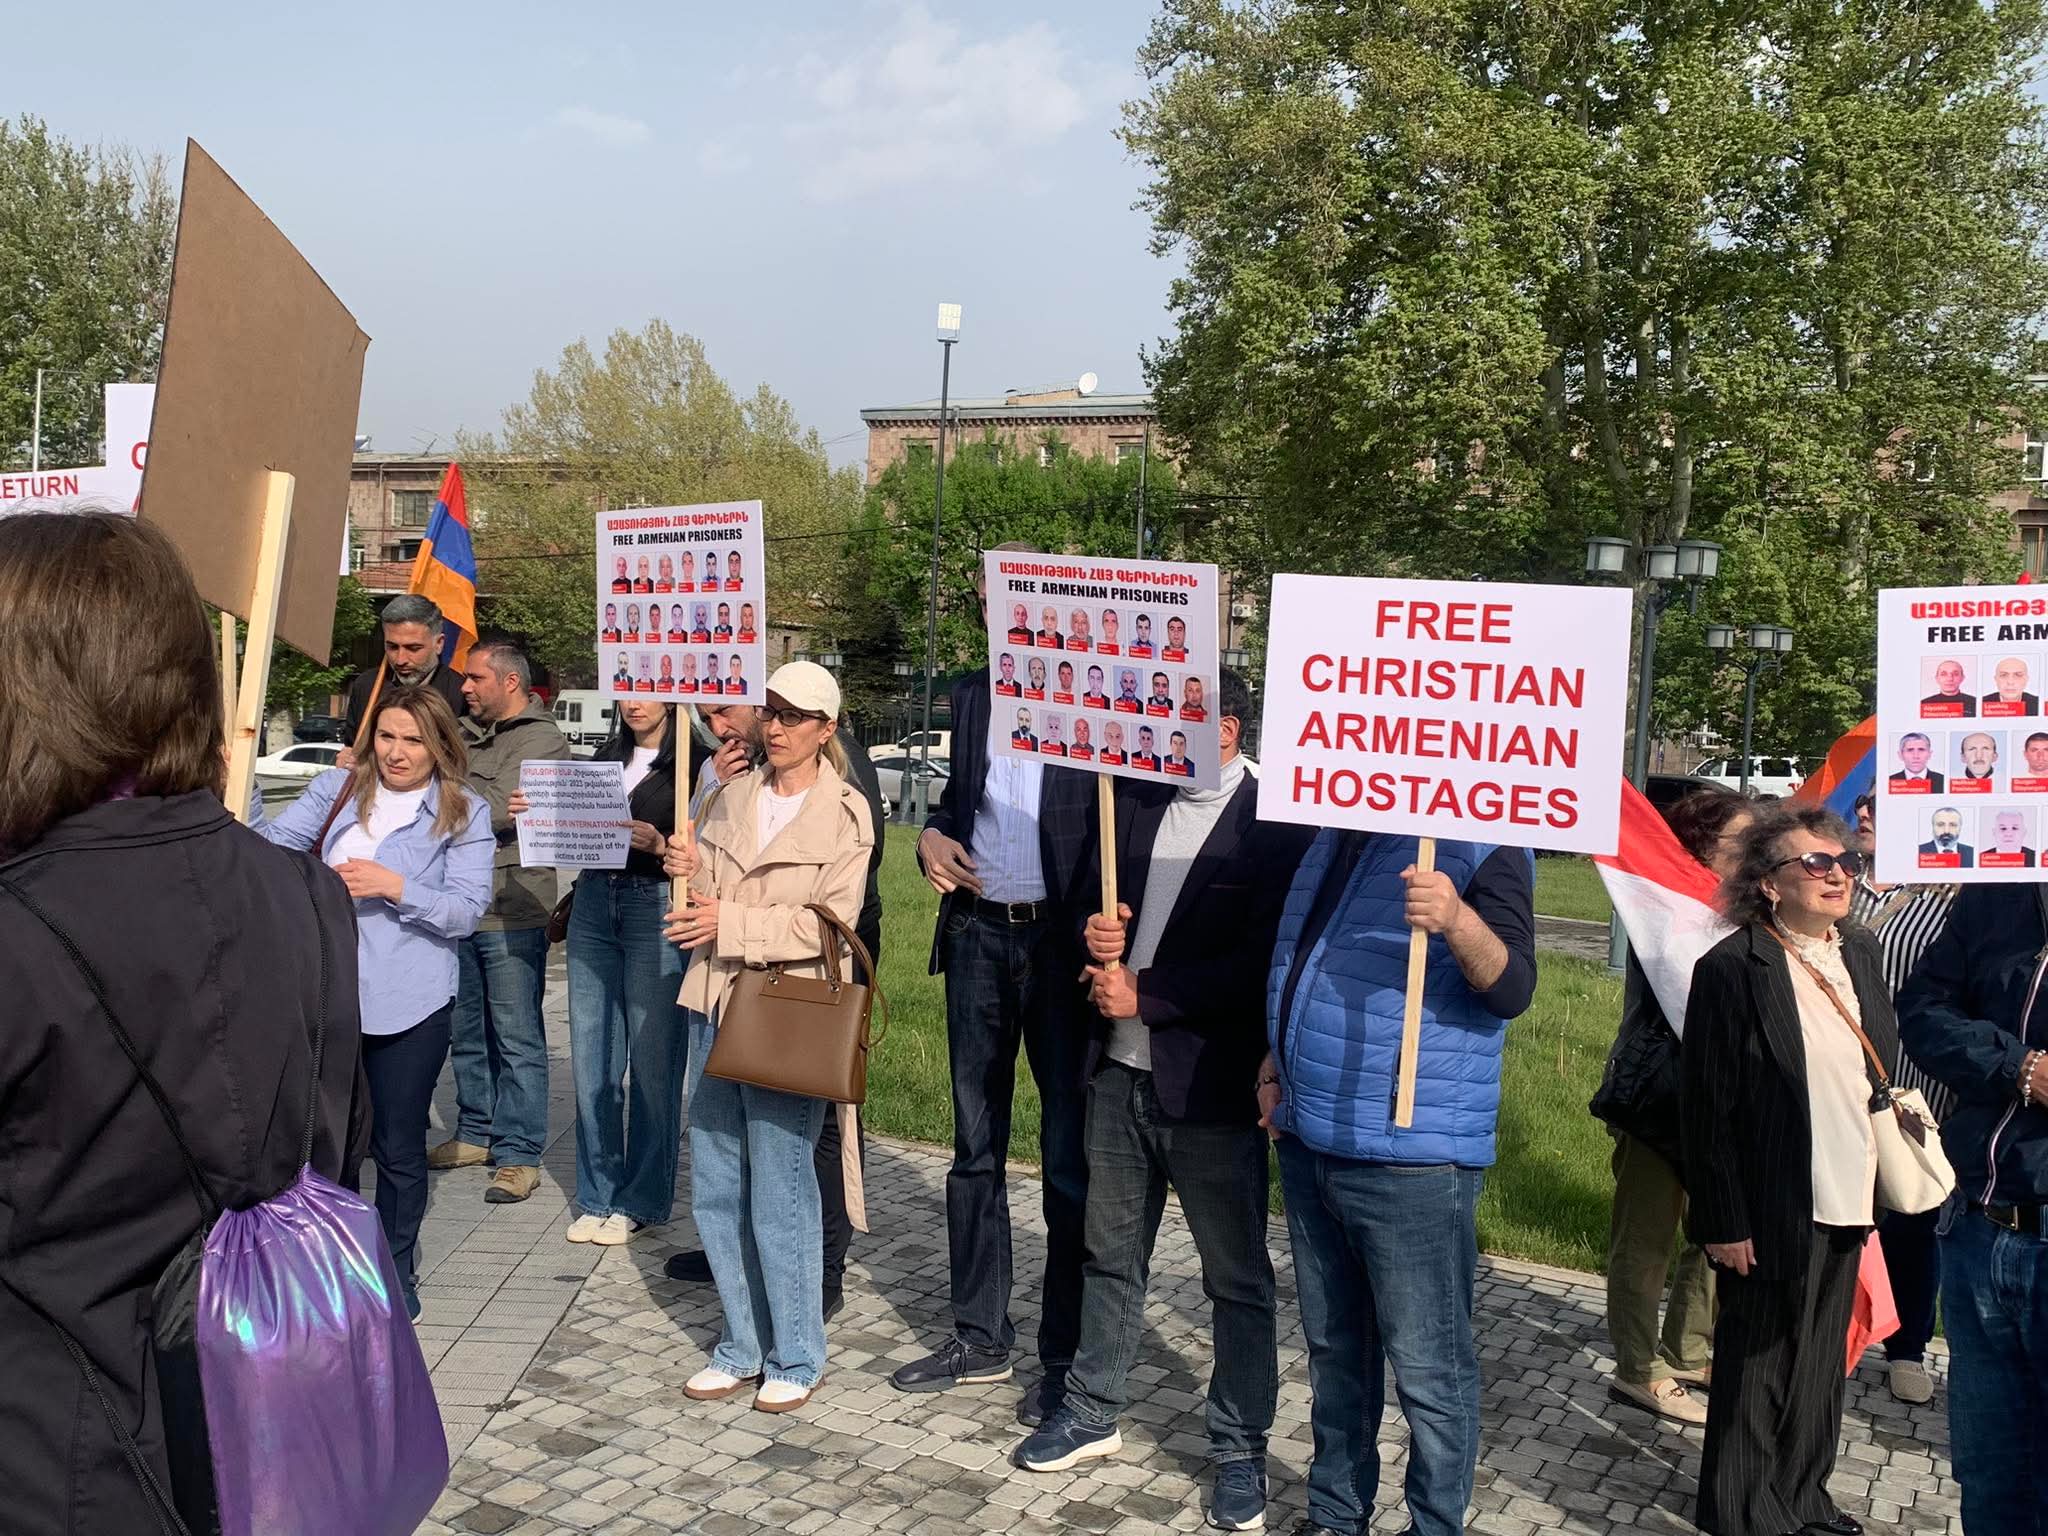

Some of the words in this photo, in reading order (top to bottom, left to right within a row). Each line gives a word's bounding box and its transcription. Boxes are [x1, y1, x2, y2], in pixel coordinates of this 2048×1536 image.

[0, 475, 79, 499] ETURN
[672, 514, 690, 527] ՀԱՅ
[613, 534, 634, 546] FREE
[637, 531, 686, 545] ARMENIAN
[688, 528, 743, 542] PRISONERS
[999, 561, 1087, 580] ԱԶԱՏՈՒԹՅՈՒՆ
[1089, 567, 1113, 581] ՀԱՅ
[1116, 570, 1198, 588] ԳԵՐԻՆԵՐԻՆ
[1008, 579, 1037, 593] FREE
[1041, 582, 1108, 600] ARMENIAN
[1111, 587, 1189, 606] PRISONERS
[1375, 600, 1513, 644] FREE
[1928, 625, 1985, 643] FREE
[1301, 654, 1585, 708] CHRISTIAN
[1297, 711, 1579, 769] ARMENIAN
[1292, 766, 1579, 829] HOSTAGES
[523, 820, 535, 828] WE
[535, 819, 553, 828] CALL
[555, 820, 568, 828] FOR
[568, 820, 624, 829] INTERNATIONA
[603, 831, 616, 839] the
[605, 842, 613, 850] of
[614, 842, 626, 850] the
[576, 853, 583, 861] of
